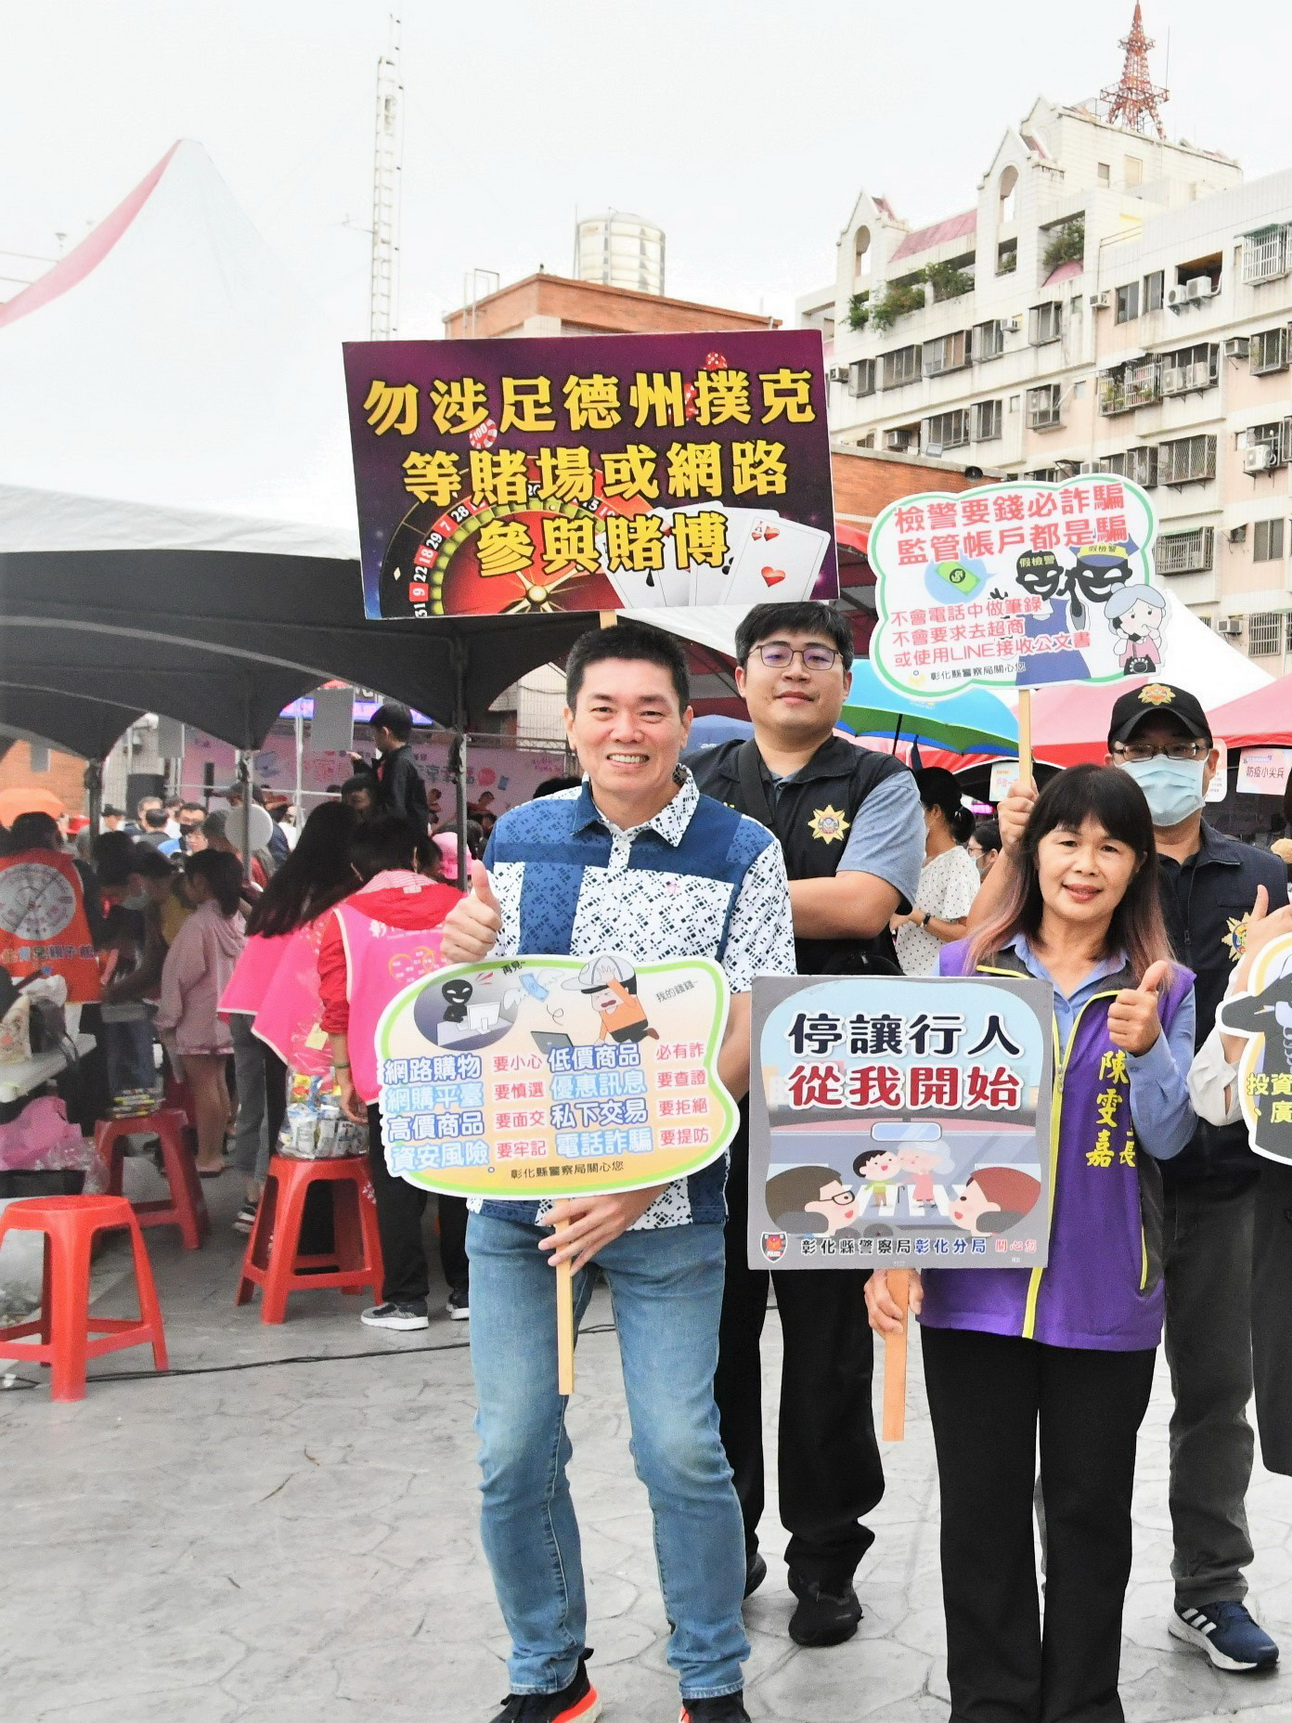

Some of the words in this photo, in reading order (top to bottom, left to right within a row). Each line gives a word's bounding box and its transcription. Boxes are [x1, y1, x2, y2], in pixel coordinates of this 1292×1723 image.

[362, 367, 817, 437] 勿涉足德州撲克
[402, 438, 789, 507] 等賭場或網路
[451, 505, 469, 523] 28
[894, 482, 1125, 534] 檢警要錢必詐騙
[426, 532, 443, 550] 29
[440, 520, 452, 532] 7
[896, 514, 1128, 566] 監管帳戶都是騙
[418, 548, 434, 565] 18
[477, 510, 730, 578] 參與賭博
[413, 566, 427, 582] 22
[890, 596, 1042, 628] 不會電話中做筆錄
[892, 619, 1025, 647] 不會要求去超商
[894, 632, 1091, 668] 或使用LINE接收公文書
[788, 1012, 1020, 1056] 停讓行人
[384, 1055, 482, 1085] 網路購物
[493, 1053, 543, 1073] 要小心
[549, 1041, 642, 1074] 低價商品
[656, 1043, 705, 1061] 必有詐
[385, 1082, 484, 1113] 網購平臺
[494, 1081, 544, 1101] 要慎選
[550, 1070, 647, 1101] 優惠訊息
[657, 1069, 707, 1089] 要查證
[788, 1065, 1021, 1107] 從我開始
[550, 1098, 648, 1130] 私下交易
[659, 1098, 708, 1116] 要拒絕
[1085, 1049, 1130, 1168] 陳雯嘉
[387, 1111, 485, 1143] 高價商品
[495, 1110, 546, 1130] 要面交
[391, 1139, 490, 1173] 資安風險
[497, 1140, 547, 1158] 要牢記
[555, 1127, 653, 1159] 電話詐騙
[660, 1127, 710, 1146] 要提防
[510, 1160, 624, 1180] 彰化縣警察局關心您
